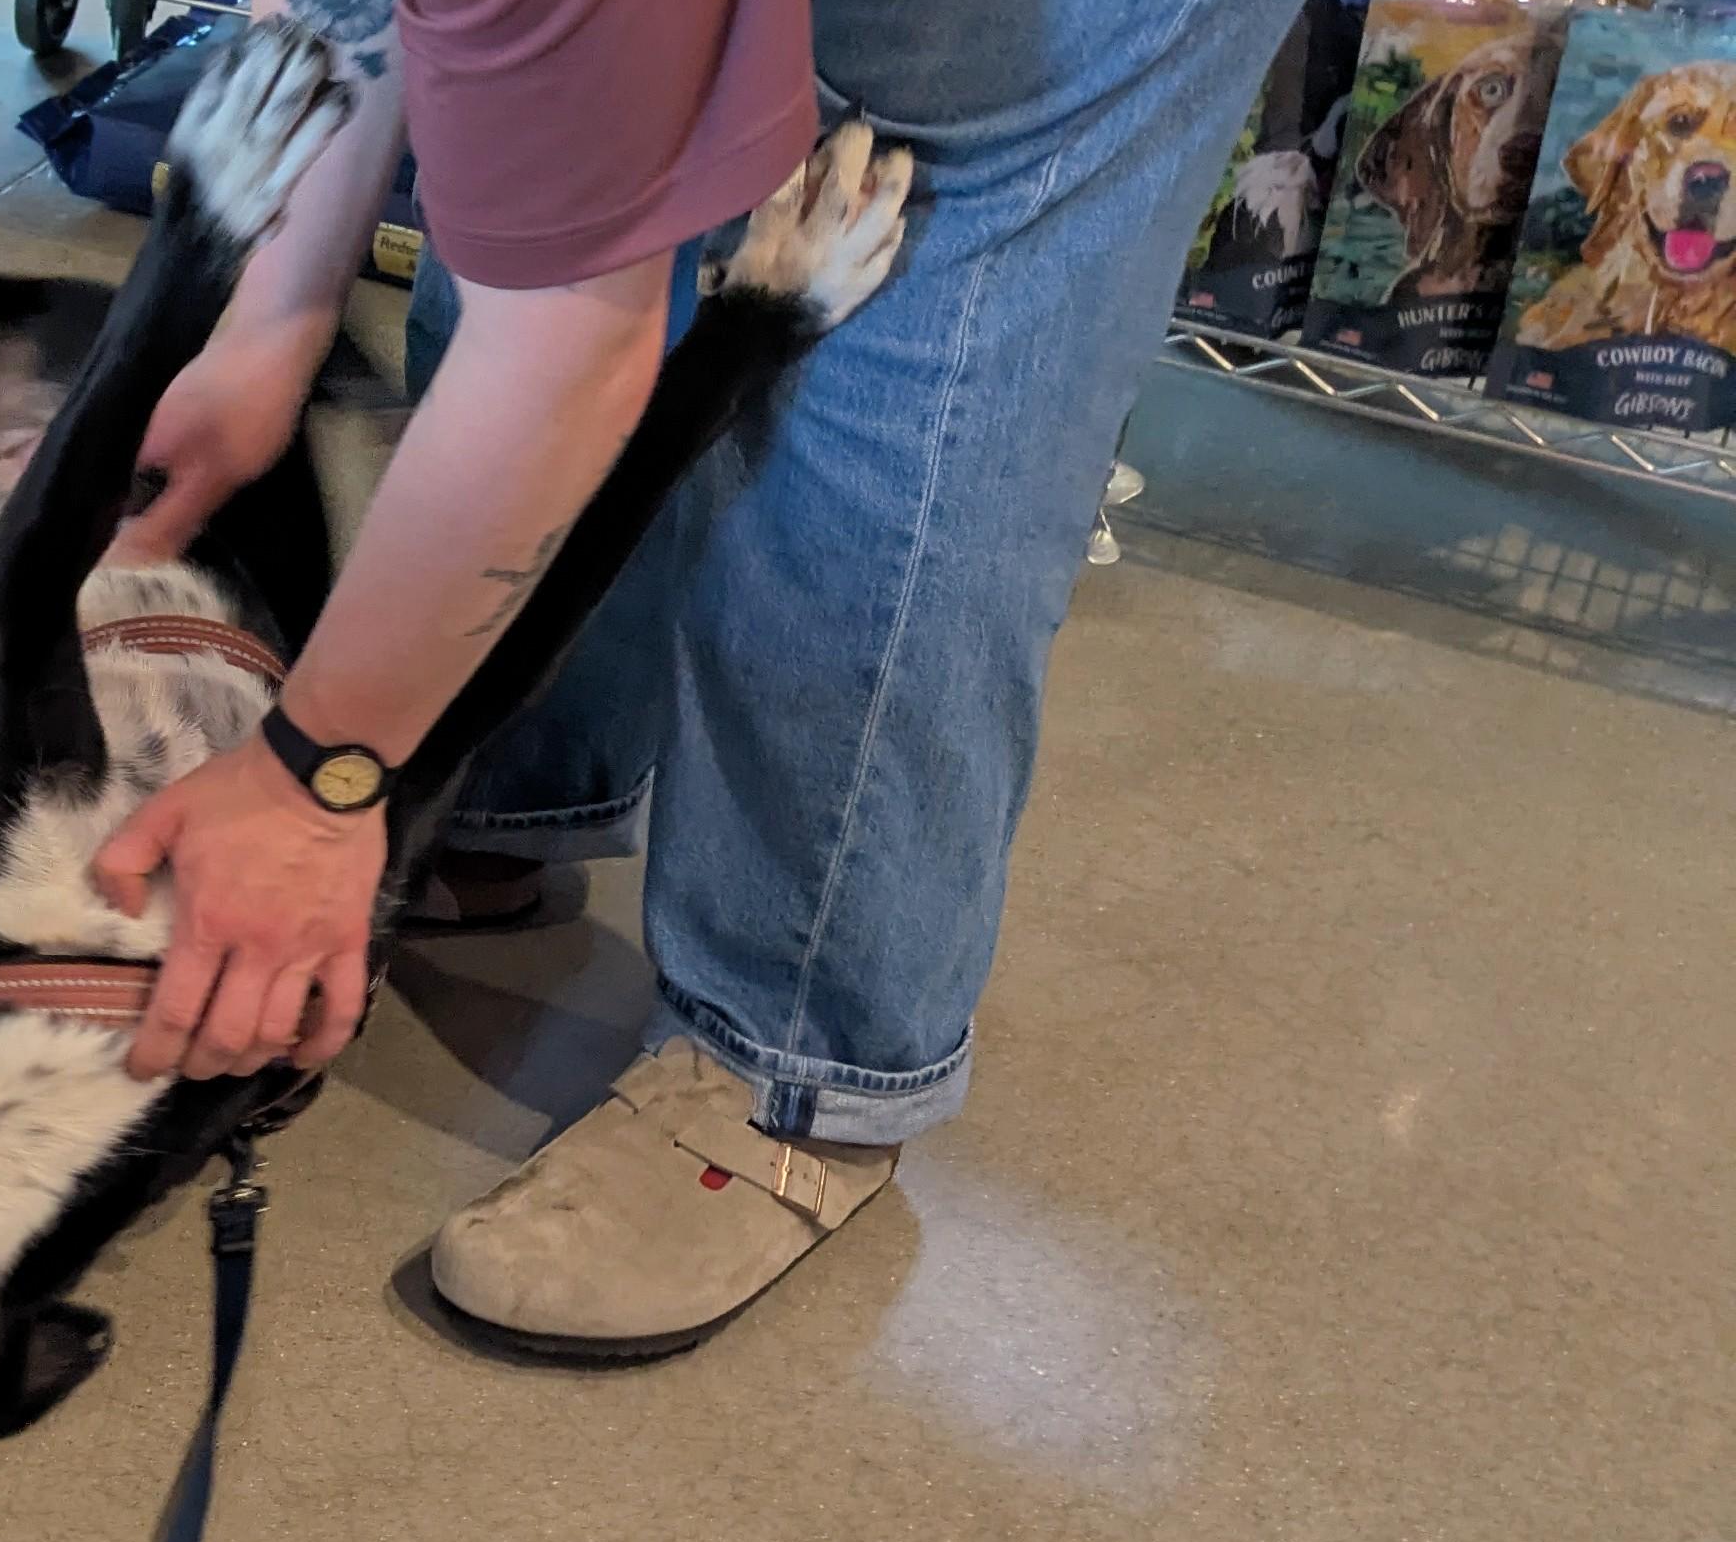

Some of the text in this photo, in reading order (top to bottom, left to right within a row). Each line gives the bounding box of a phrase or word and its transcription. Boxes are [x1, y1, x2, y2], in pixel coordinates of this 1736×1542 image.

[1251, 263, 1306, 292] COUNT
[1596, 344, 1729, 379] COWBOY BACON
